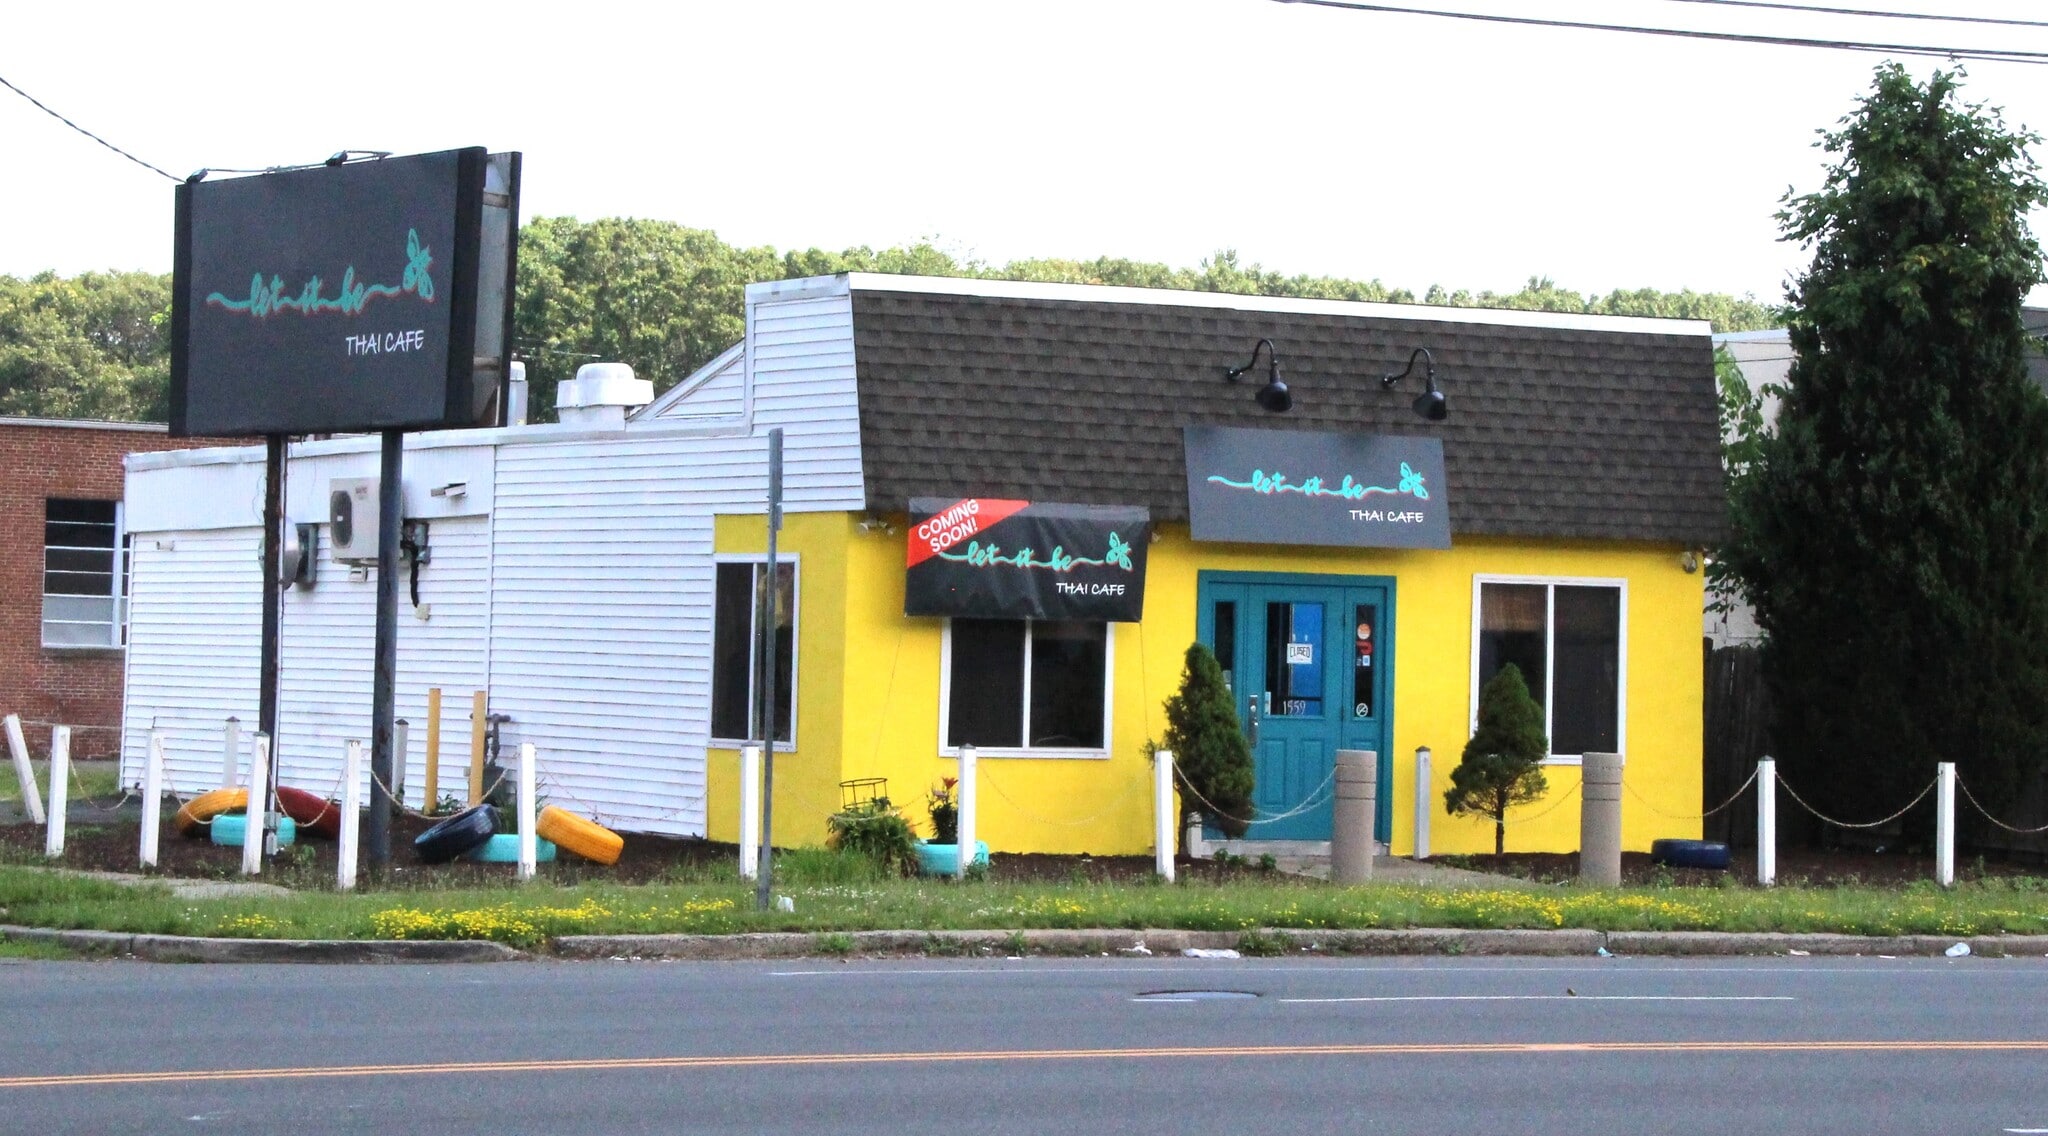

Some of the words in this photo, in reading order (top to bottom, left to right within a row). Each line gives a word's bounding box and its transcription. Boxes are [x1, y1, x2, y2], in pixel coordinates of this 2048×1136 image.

[346, 334, 381, 356] THAI
[385, 329, 425, 352] CAFE
[918, 499, 979, 540] COMING
[1349, 509, 1384, 522] THAI
[1387, 511, 1424, 523] CAFE
[930, 517, 978, 553] SOON!
[1056, 583, 1088, 594] THAI
[1091, 584, 1125, 595] CAFE
[1289, 646, 1311, 658] CLOSED
[1283, 701, 1306, 715] 1559
